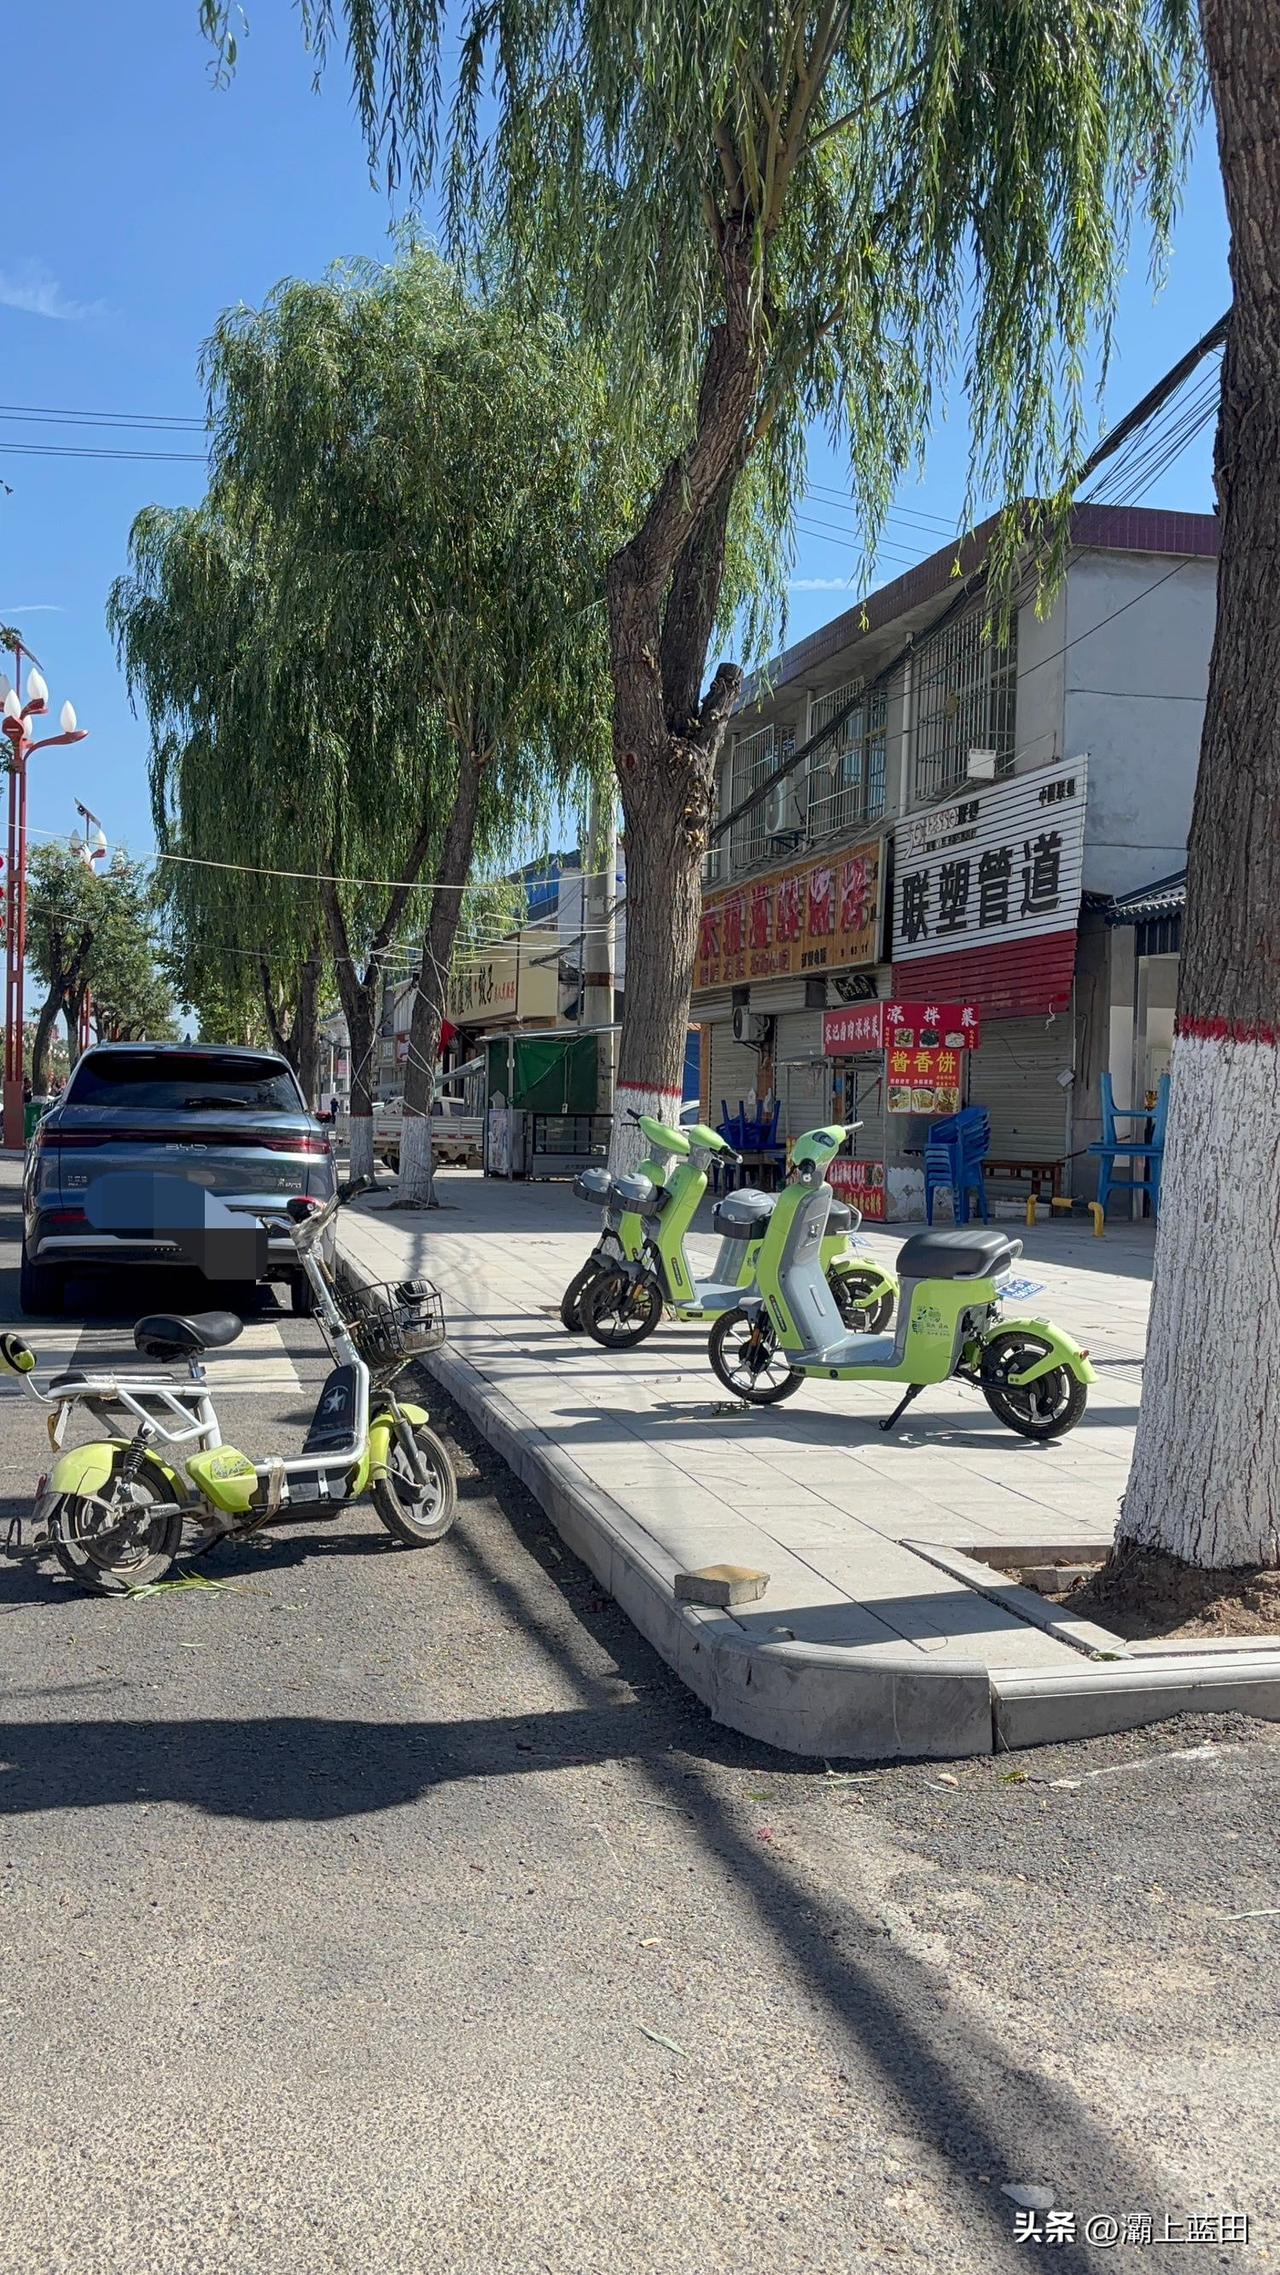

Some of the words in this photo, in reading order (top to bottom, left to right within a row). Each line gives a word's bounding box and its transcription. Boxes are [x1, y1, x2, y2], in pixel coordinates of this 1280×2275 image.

[901, 830, 1063, 943] 联塑管道
[886, 1005, 979, 1027] 凉拌菜
[890, 1051, 957, 1074] 酱香饼
[164, 1143, 208, 1152] BYD
